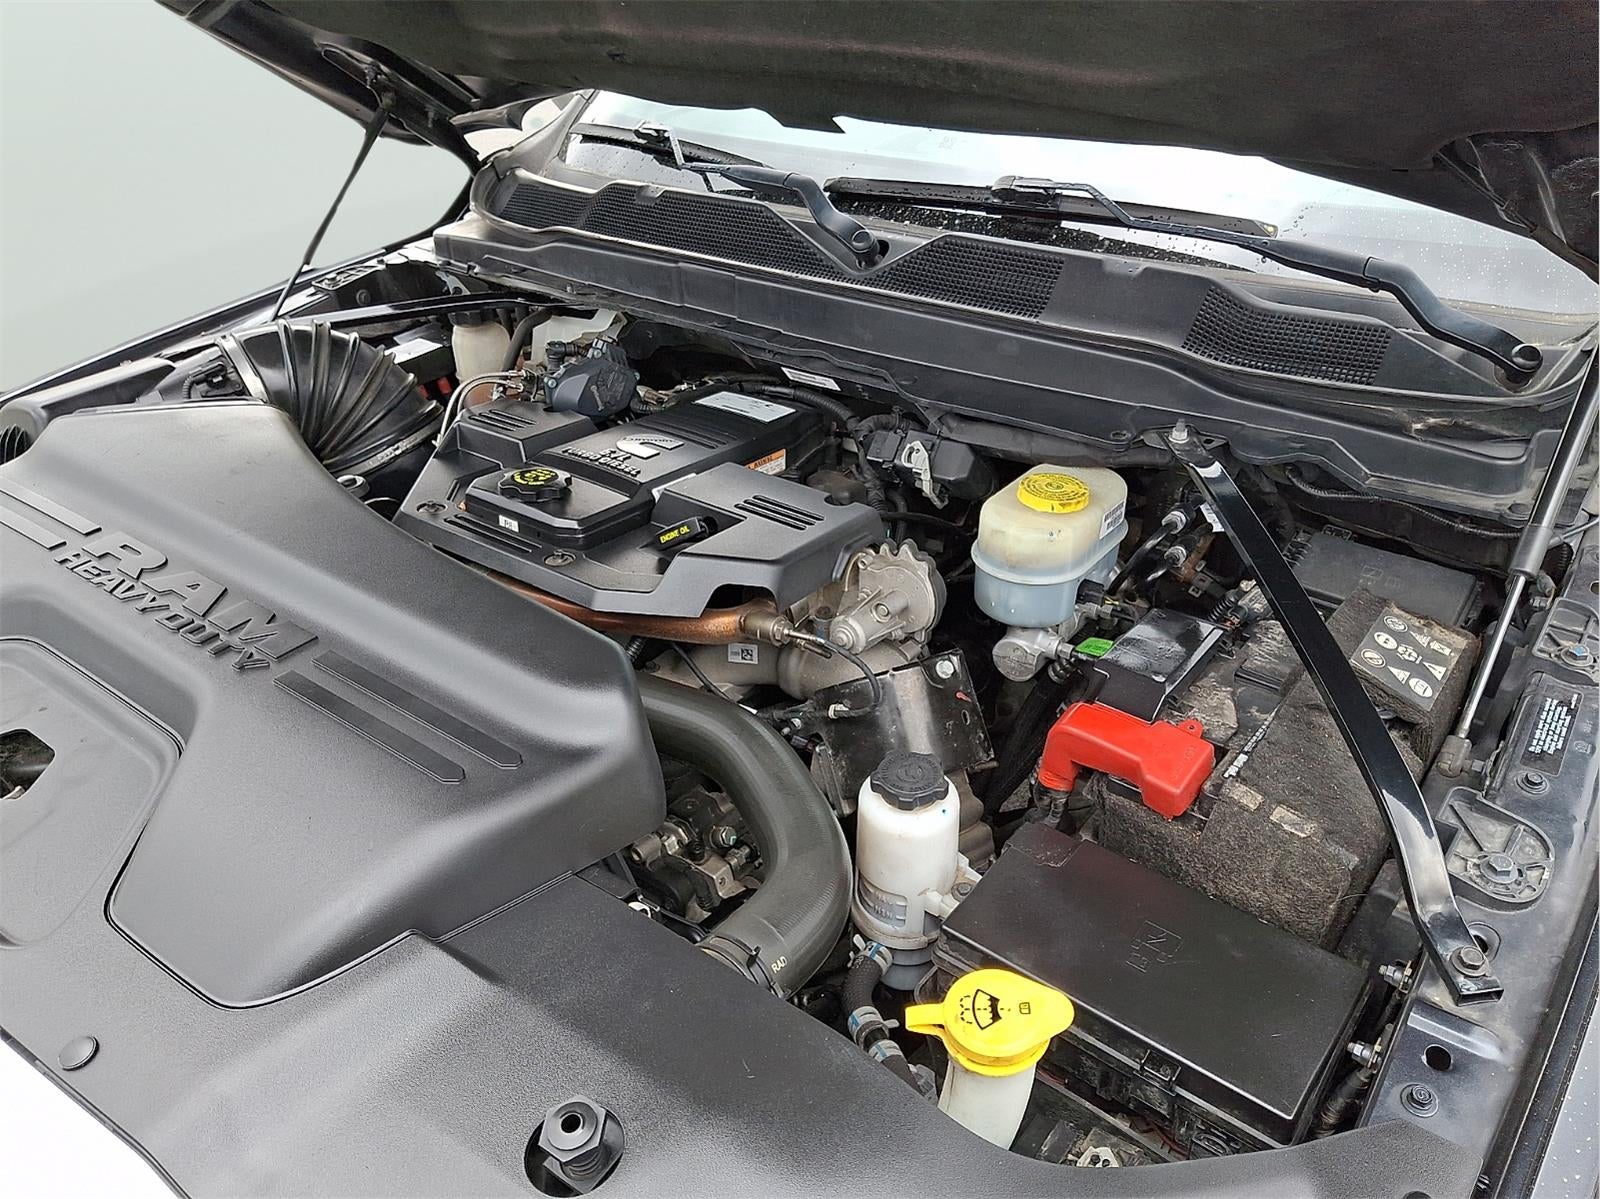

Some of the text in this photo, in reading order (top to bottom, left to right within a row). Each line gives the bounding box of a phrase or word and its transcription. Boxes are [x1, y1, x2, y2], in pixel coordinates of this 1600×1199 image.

[562, 447, 641, 477] TURBO DIESEL
[54, 551, 271, 671] HEAVY DUTY
[82, 531, 318, 661] RAM
[771, 955, 788, 974] RAD
